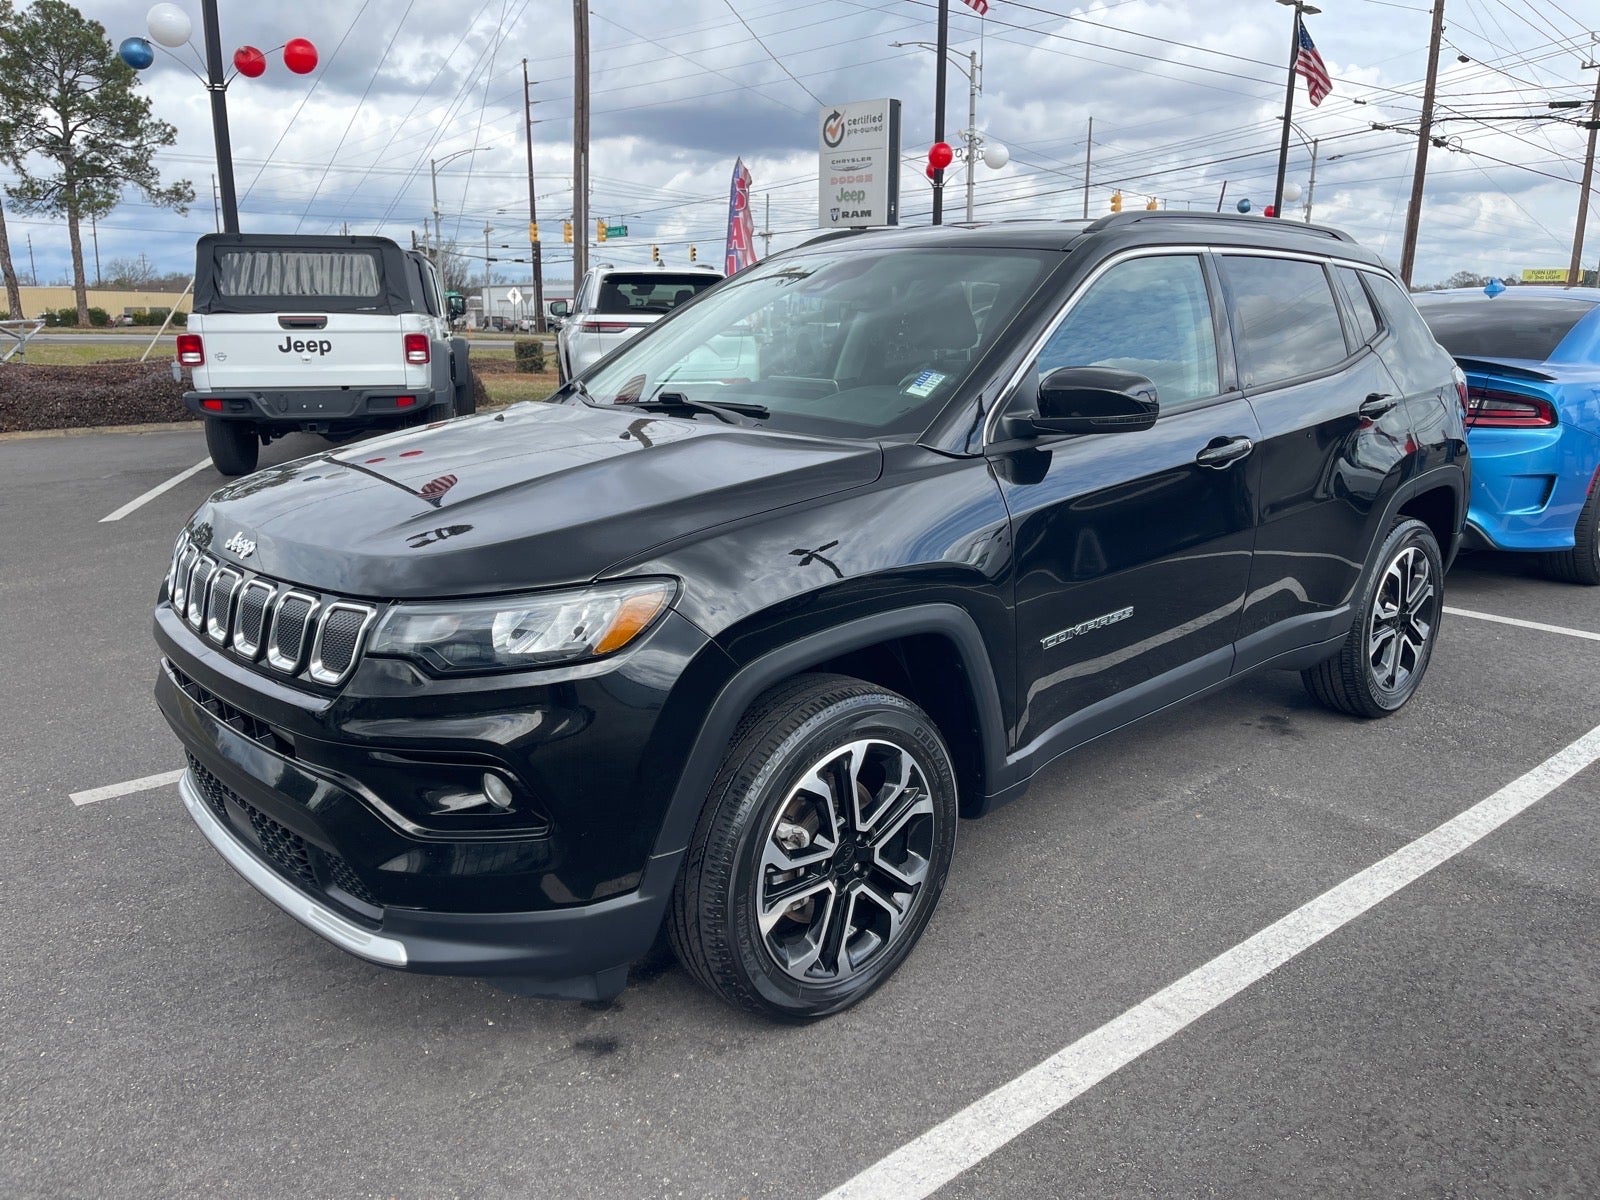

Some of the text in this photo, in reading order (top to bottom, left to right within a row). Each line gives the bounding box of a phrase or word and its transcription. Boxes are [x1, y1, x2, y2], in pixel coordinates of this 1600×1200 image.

[847, 113, 883, 125] certified
[847, 125, 883, 136] pre-owned
[831, 156, 872, 164] CHRYSLER
[830, 174, 873, 185] DODGE
[835, 187, 866, 204] Jeep
[841, 209, 872, 219] RAM
[277, 335, 332, 356] Jeep
[224, 531, 257, 560] Jeep
[1040, 606, 1134, 649] COMPASS
